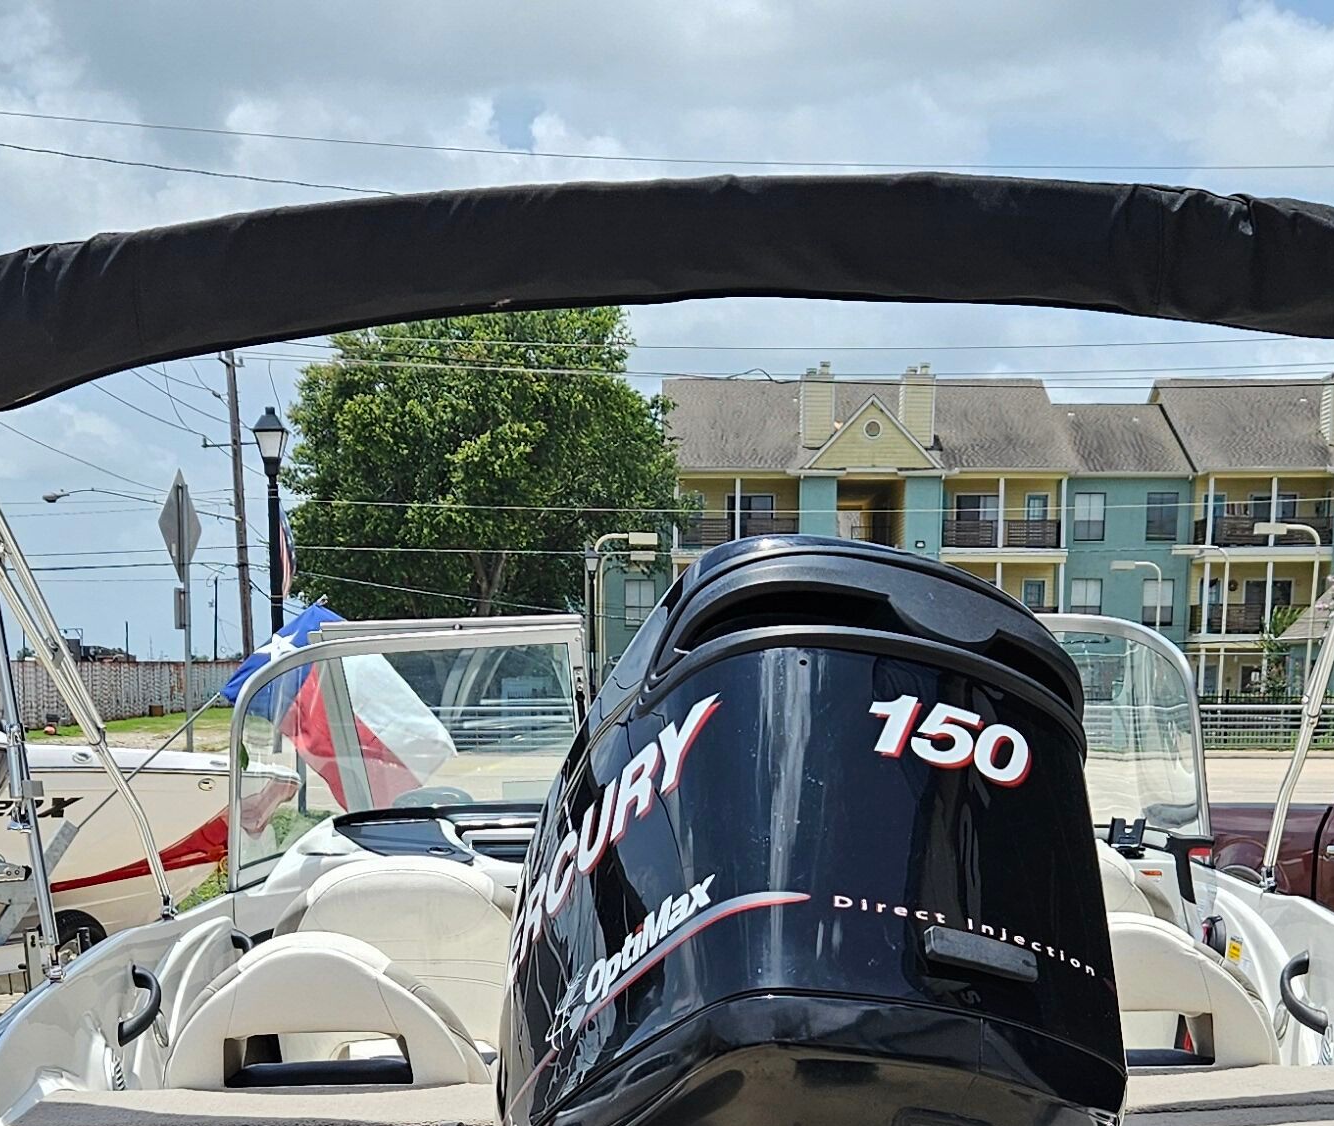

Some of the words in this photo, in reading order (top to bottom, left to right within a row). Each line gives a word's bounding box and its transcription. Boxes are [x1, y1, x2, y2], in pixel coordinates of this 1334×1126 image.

[869, 694, 1033, 788] 150
[585, 873, 716, 1003] OptiMax
[832, 894, 946, 924] Direct
[966, 917, 1097, 977] Injection
